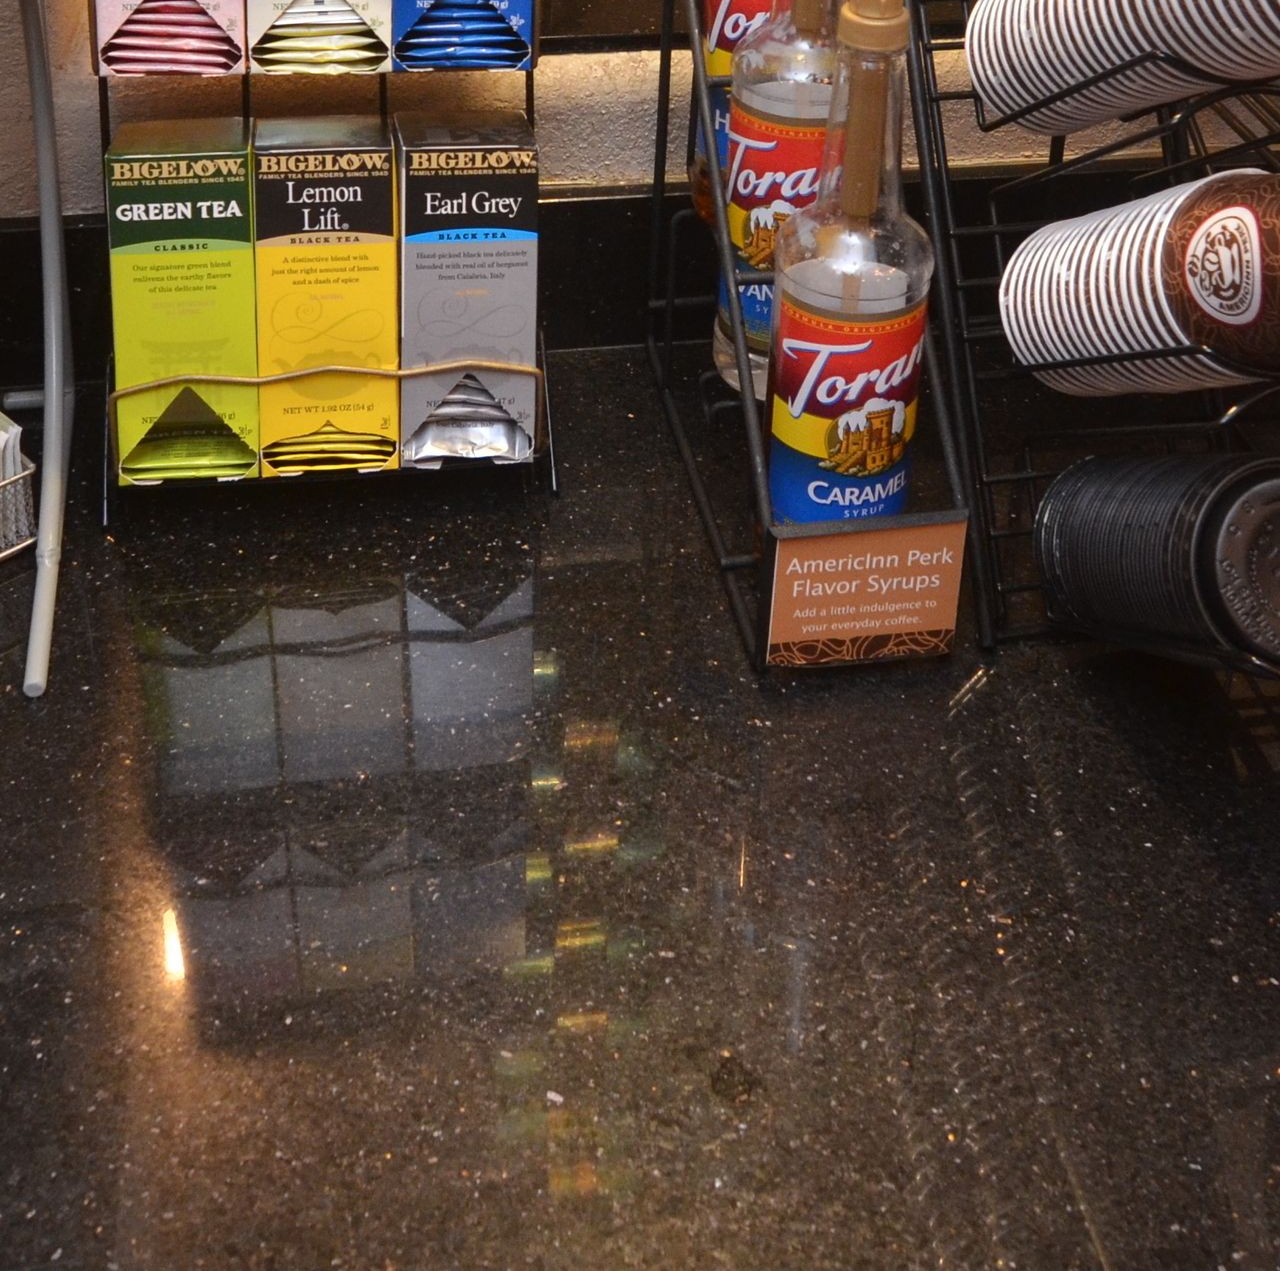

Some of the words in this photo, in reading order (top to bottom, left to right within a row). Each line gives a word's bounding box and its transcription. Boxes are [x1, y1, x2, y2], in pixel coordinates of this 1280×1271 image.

[111, 159, 244, 179] BIGELOW
[258, 153, 388, 173] BIGELOW
[410, 151, 537, 170] BIGELOW
[112, 179, 138, 187] FAMILY
[158, 177, 199, 185] BLENDERS
[201, 176, 224, 184] SINCE
[346, 170, 369, 178] SINCE
[409, 169, 435, 177] FAMILY
[453, 168, 493, 176] BLENDERS
[286, 181, 363, 203] Lemon
[115, 202, 192, 221] GREEN
[196, 199, 243, 219] TEA
[424, 192, 468, 215] Earl
[471, 191, 523, 219] Grey
[154, 243, 209, 251] CLASSIC
[290, 236, 331, 244] BLACK
[336, 235, 361, 243] TEA
[1218, 259, 1254, 312] AMERICINN
[283, 406, 302, 415] NET
[304, 405, 319, 414] WT
[807, 471, 907, 507] CARAMEL
[842, 504, 885, 519] SYRUP
[786, 552, 899, 576] AmericInn
[907, 547, 954, 568] Perk
[792, 579, 861, 598] Flavor
[866, 574, 941, 595] Syrups
[793, 608, 817, 619] Add
[819, 609, 827, 617] a
[830, 605, 856, 616] little
[859, 601, 922, 615] indulgence
[924, 599, 938, 609] to
[801, 624, 828, 634] your
[831, 618, 883, 632] everyday
[884, 614, 923, 626] coffee.
